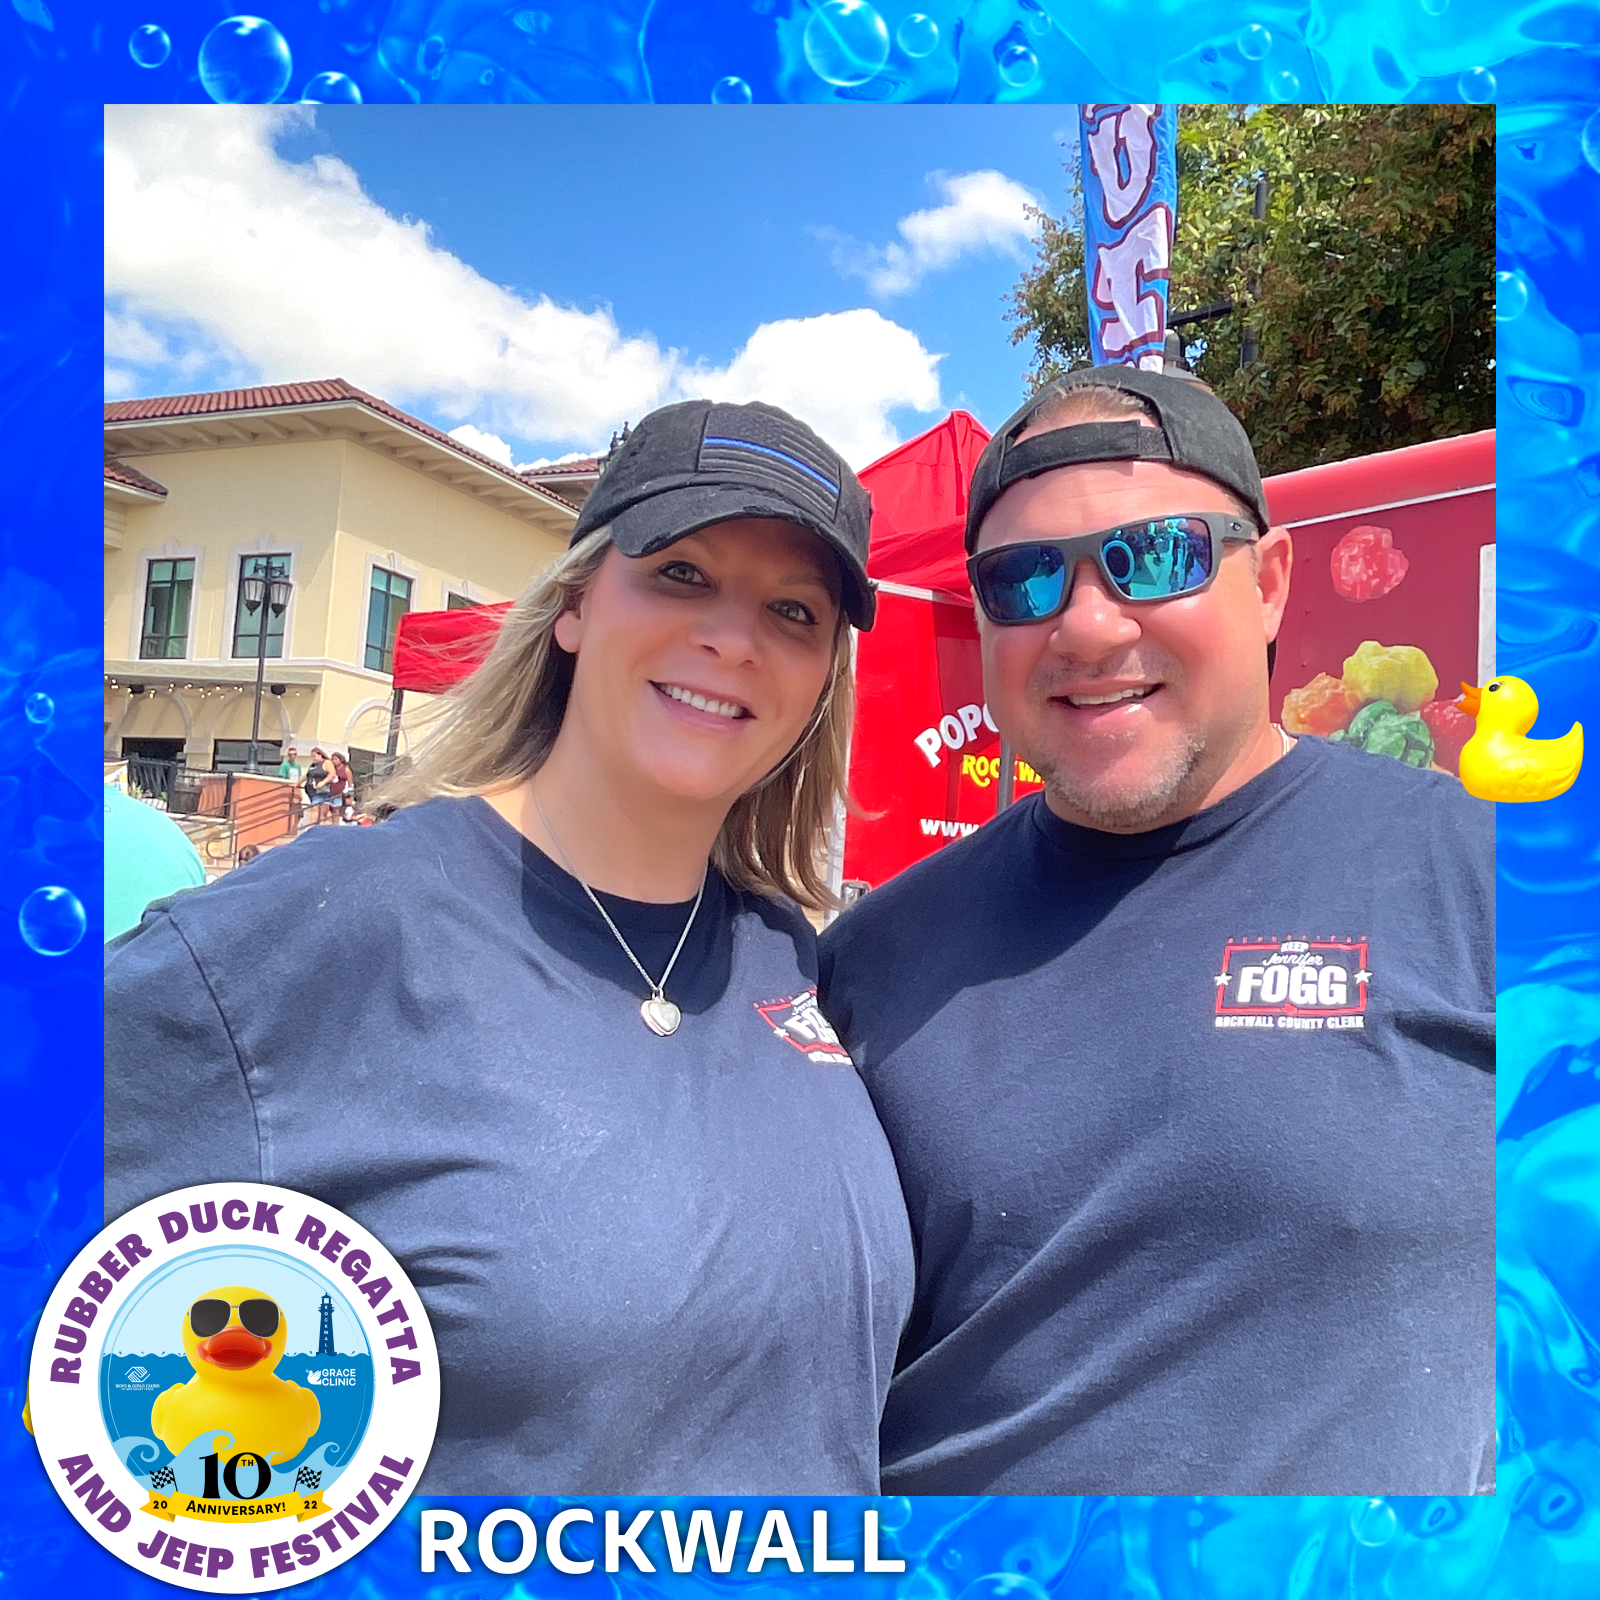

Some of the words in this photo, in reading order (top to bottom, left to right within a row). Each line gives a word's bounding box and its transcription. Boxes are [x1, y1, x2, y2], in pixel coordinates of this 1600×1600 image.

[1262, 952, 1323, 971] Jennifer
[1237, 965, 1348, 1005] FOGG
[1215, 1016, 1274, 1028] ROCKWALL
[1278, 1016, 1324, 1029] COUNTY
[1327, 1016, 1364, 1029] CLERK
